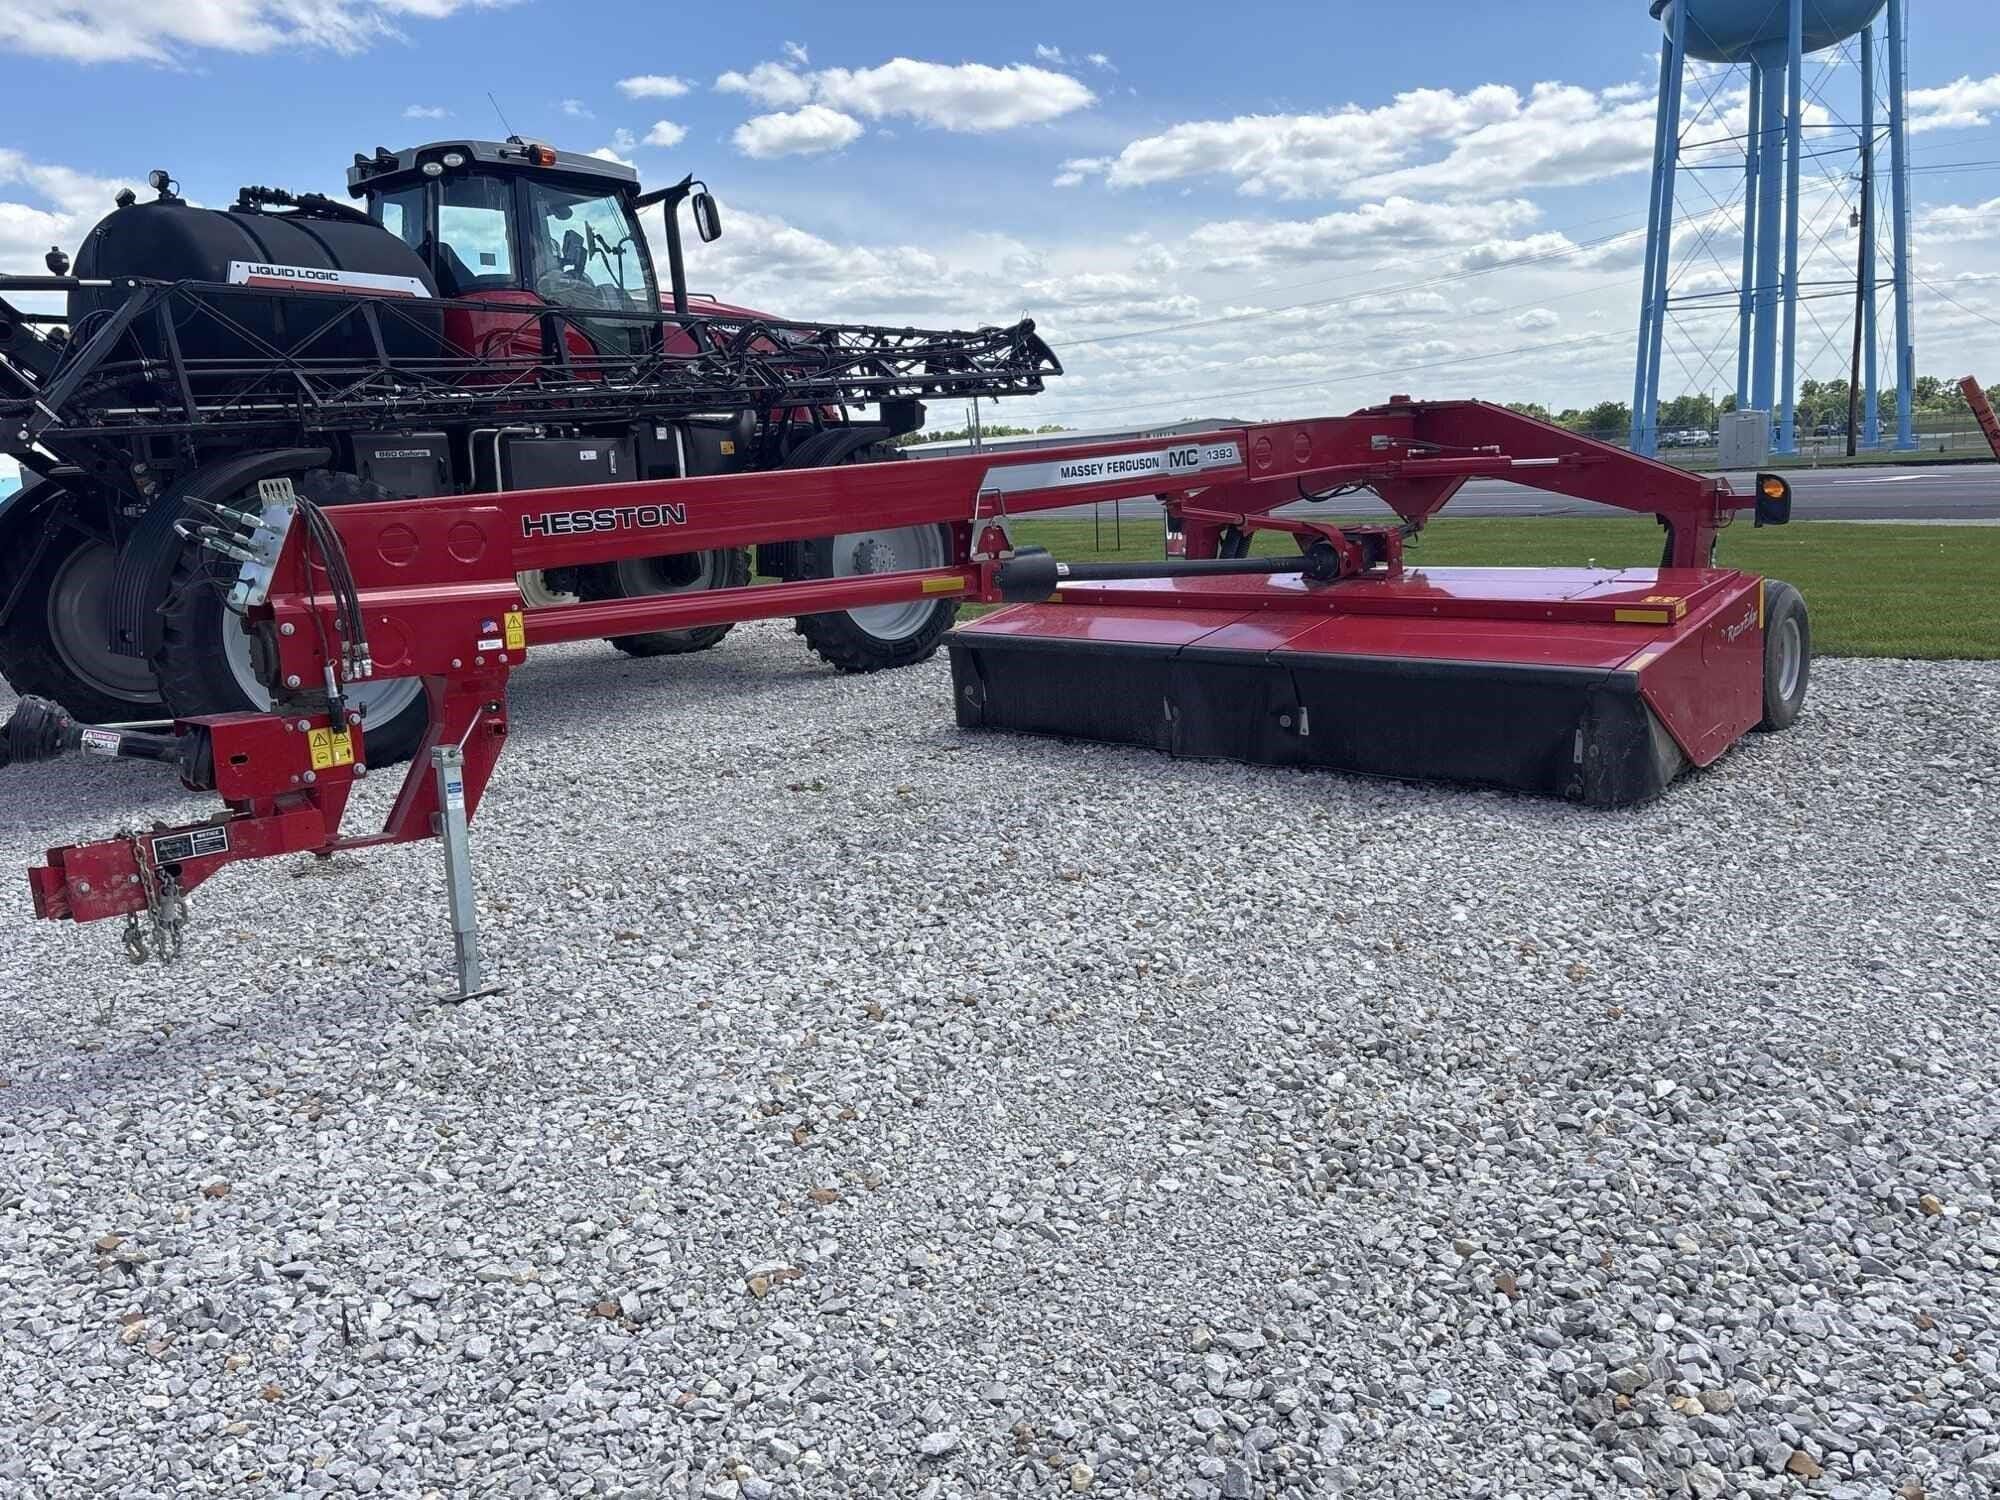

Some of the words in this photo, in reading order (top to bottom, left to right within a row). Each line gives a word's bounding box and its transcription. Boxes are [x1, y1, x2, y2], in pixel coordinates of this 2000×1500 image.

[248, 265, 295, 277] LIQUID
[297, 269, 339, 281] LOGIC
[1060, 463, 1104, 479] MASSEY
[1107, 457, 1160, 474] FERGUSON
[1168, 448, 1199, 468] MC
[1206, 448, 1233, 460] 1393
[521, 503, 687, 538] HESSTON
